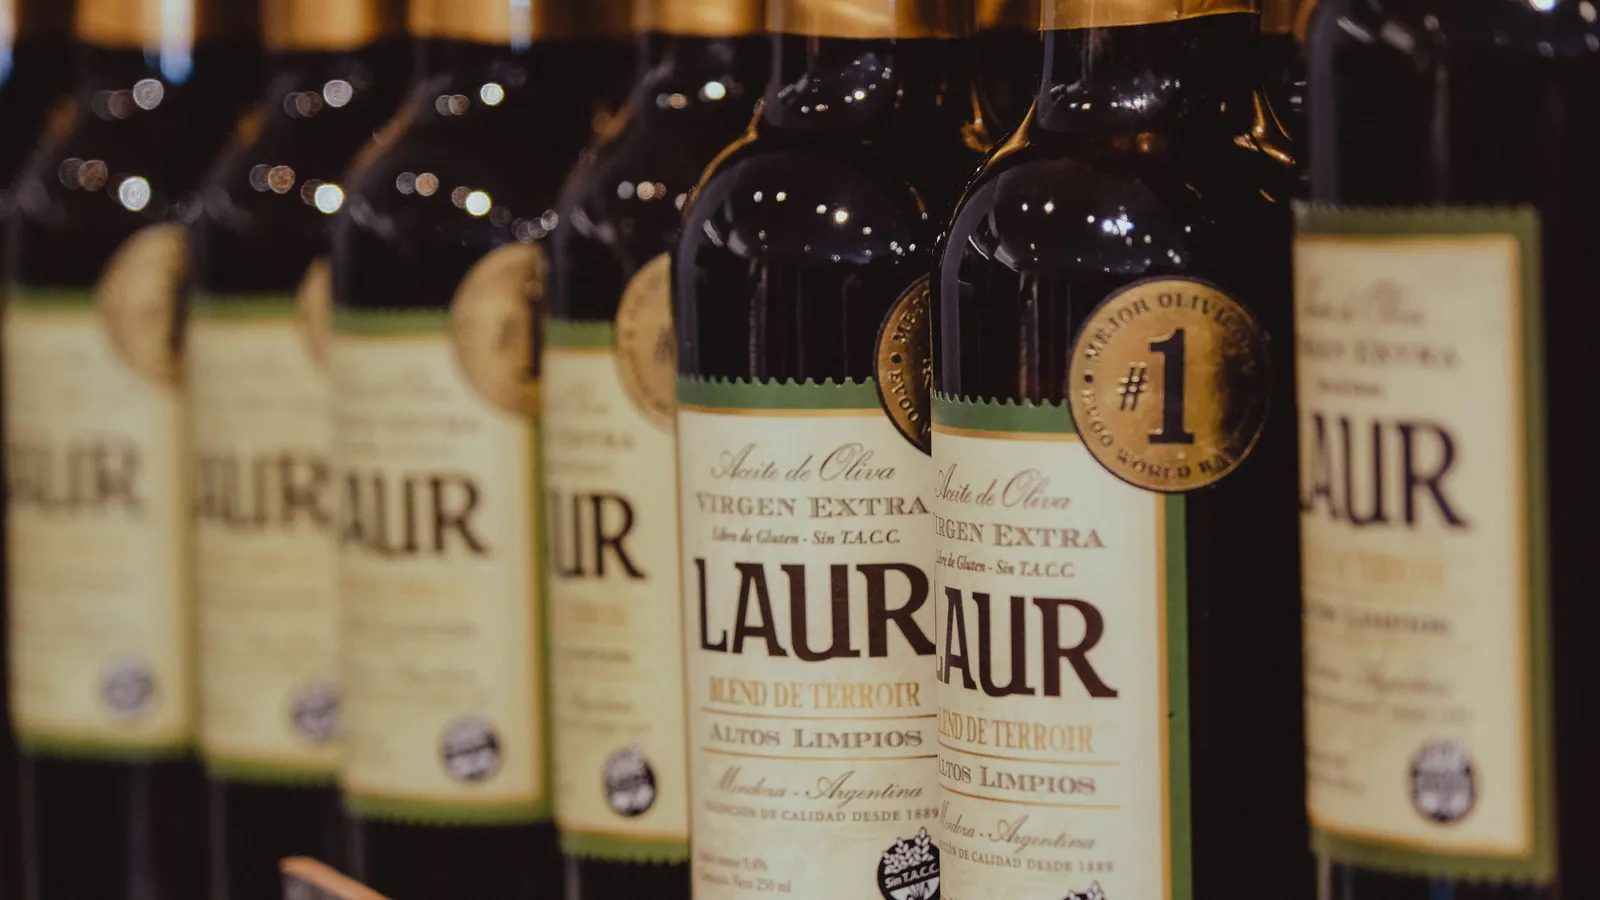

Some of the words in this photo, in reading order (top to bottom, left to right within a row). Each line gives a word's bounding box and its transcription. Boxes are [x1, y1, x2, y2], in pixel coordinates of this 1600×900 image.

[1084, 298, 1150, 358] MEJOR
[887, 369, 920, 423] EVOO
[1117, 327, 1195, 445] #1
[710, 443, 779, 480] Aceite
[785, 454, 813, 481] de
[819, 442, 896, 481] Oliva
[934, 463, 972, 504] Aceite
[976, 479, 997, 506] de
[1002, 468, 1071, 510] Oliva
[696, 491, 797, 516] VIRGEN
[809, 496, 930, 518] EXTRA
[756, 530, 799, 544] Gluten
[812, 530, 835, 545] Sin
[840, 529, 900, 545] T.A.C.C.
[992, 523, 1106, 549] EXTRA
[957, 555, 986, 572] Gluten
[995, 560, 1015, 576] Sin
[1019, 561, 1076, 578] T.A.C.C.
[694, 557, 936, 662] LAUR
[709, 676, 768, 707] BLEND
[774, 681, 803, 708] DE
[809, 681, 921, 709] TERROIR
[709, 721, 780, 746] ALTOS
[792, 728, 923, 749] LIMPIOS
[967, 715, 988, 745] DE
[992, 719, 1094, 753] TERROIR
[711, 764, 786, 799] Mendoza
[805, 770, 923, 809] Argentina
[979, 766, 1096, 795] LIMPIOS
[760, 809, 777, 821] DE
[782, 809, 846, 823] CALIDAD
[852, 809, 901, 822] DESDE
[907, 808, 939, 821] 1889
[988, 814, 1096, 855] Argentina
[959, 848, 969, 860] DE
[972, 851, 1022, 869] CALIDAD
[1027, 859, 1072, 872] DESDE
[1079, 861, 1114, 873] 1889
[884, 875, 902, 889] Sin
